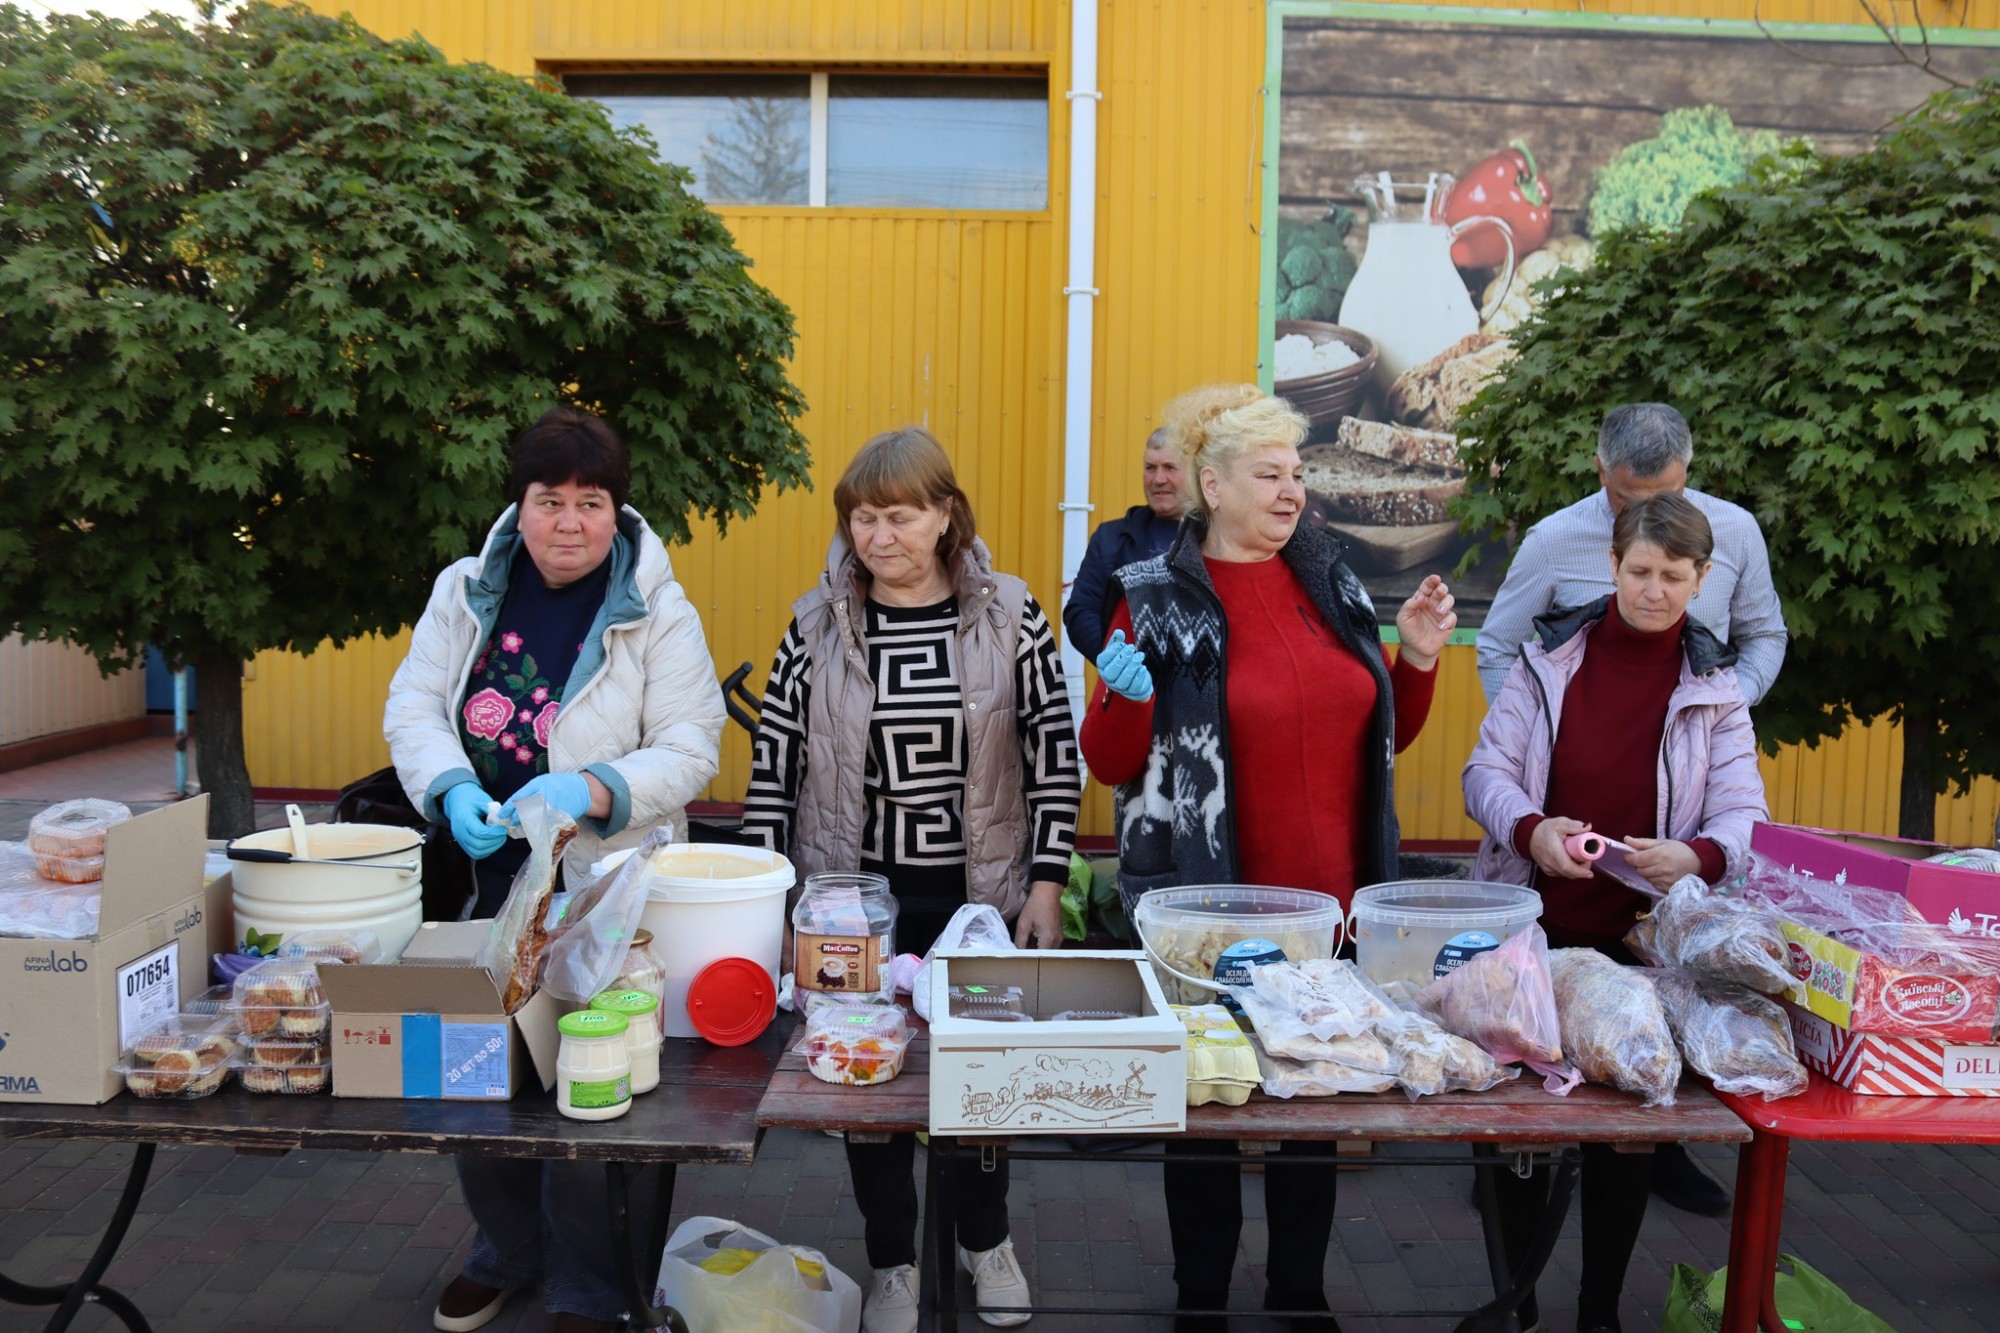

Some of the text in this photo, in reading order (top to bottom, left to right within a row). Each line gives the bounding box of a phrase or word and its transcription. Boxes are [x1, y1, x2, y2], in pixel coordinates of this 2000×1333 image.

[185, 905, 202, 929] lab
[823, 944, 859, 953] MacCoffee
[24, 964, 51, 972] brand
[50, 949, 88, 973] lab
[126, 955, 170, 998] 077654
[446, 1068, 462, 1083] 20
[460, 1059, 476, 1073] шт
[474, 1050, 488, 1063] по
[0, 1075, 40, 1091] RMA
